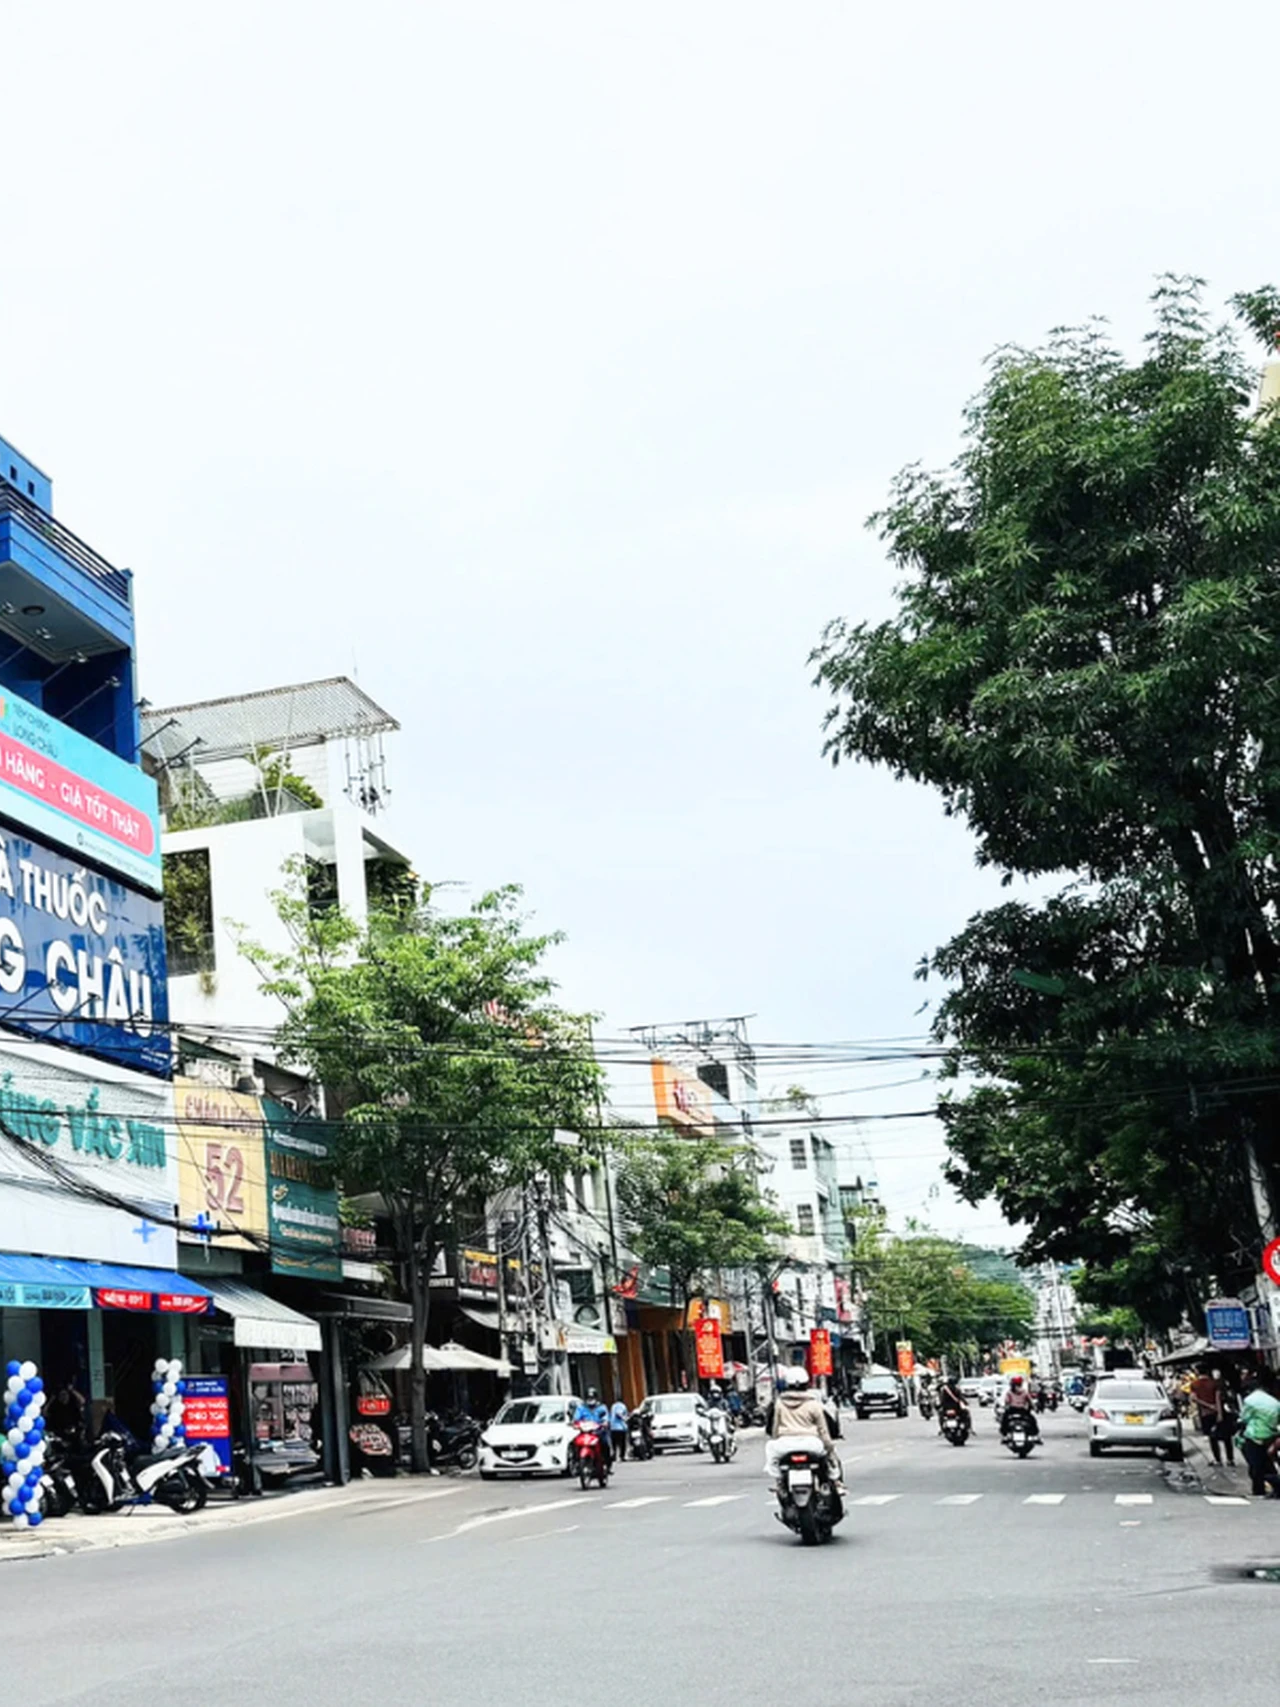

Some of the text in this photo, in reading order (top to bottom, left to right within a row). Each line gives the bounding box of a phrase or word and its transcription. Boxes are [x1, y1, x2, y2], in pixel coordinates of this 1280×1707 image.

[60, 781, 84, 811] GIÁ
[84, 793, 109, 824] TỐT
[19, 866, 109, 936] THUỐC
[45, 940, 153, 1039] CHÂU
[65, 1085, 123, 1160] VẮC
[125, 1119, 167, 1169] XIN
[205, 1142, 245, 1215] 52
